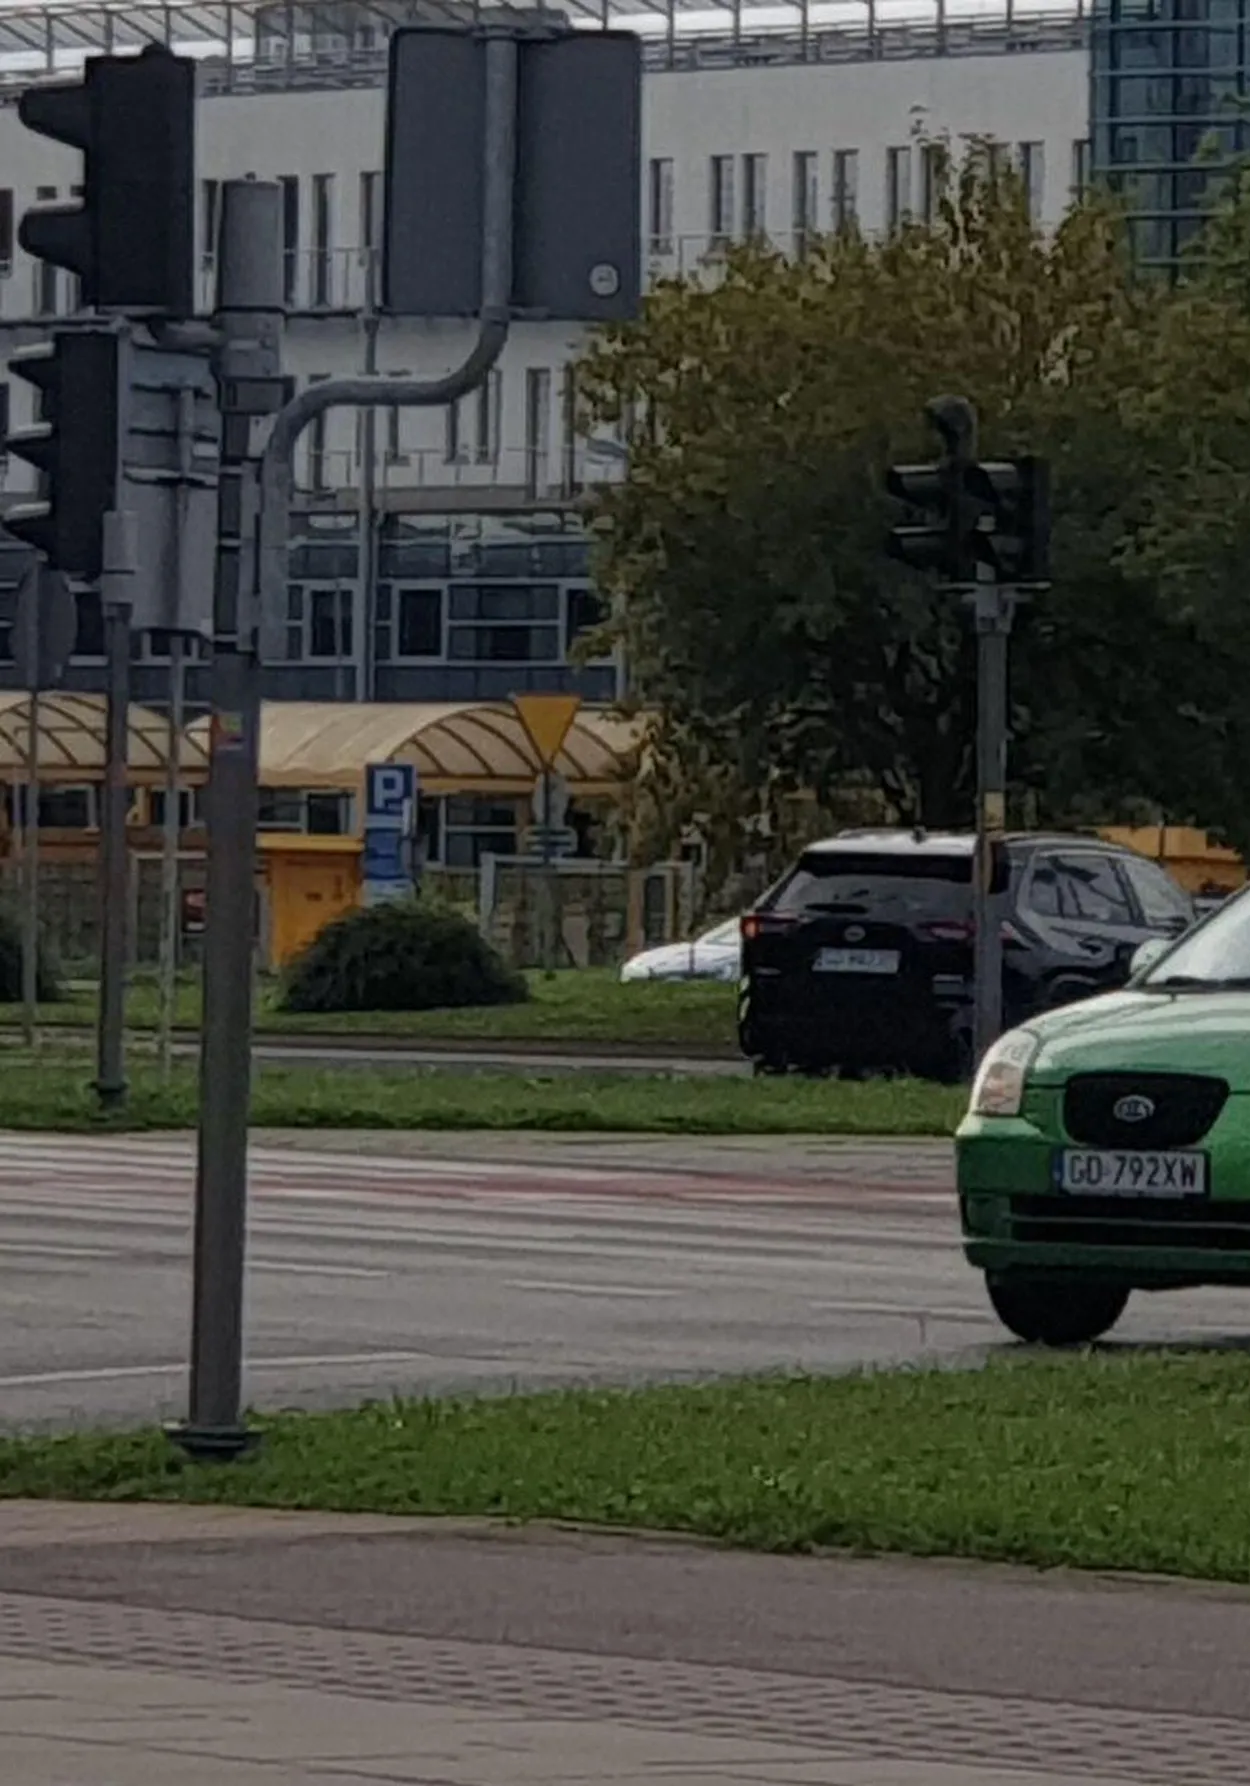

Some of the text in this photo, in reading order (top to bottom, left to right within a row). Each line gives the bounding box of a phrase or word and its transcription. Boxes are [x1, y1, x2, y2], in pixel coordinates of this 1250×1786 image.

[374, 768, 404, 809] P
[1069, 1155, 1197, 1188] GD 792XW
